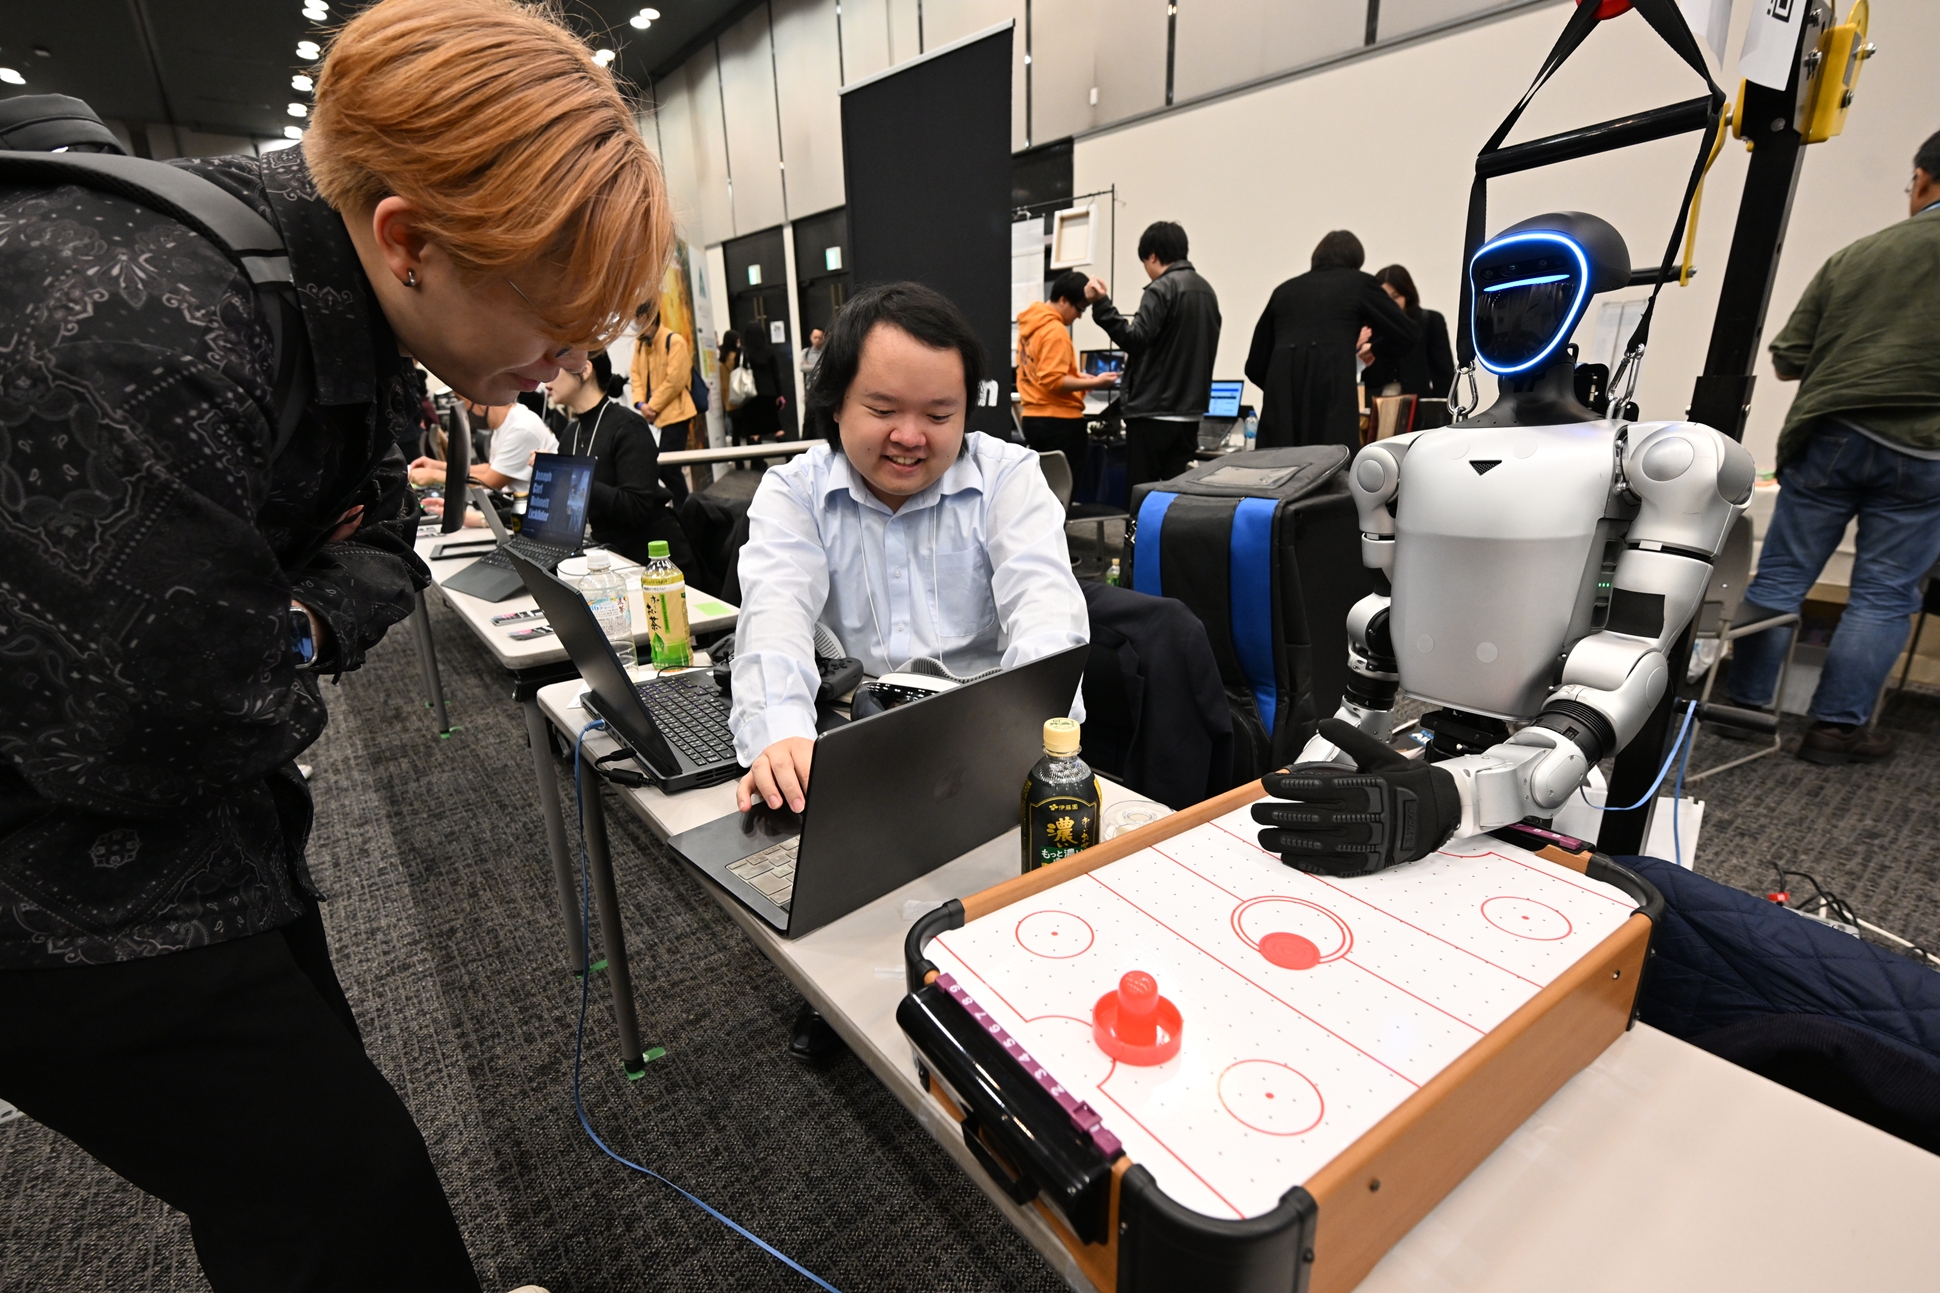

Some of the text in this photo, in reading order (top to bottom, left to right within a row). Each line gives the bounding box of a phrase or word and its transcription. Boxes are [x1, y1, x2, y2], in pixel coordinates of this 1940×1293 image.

[961, 996, 973, 1006] 8
[974, 1011, 986, 1020] 7
[1003, 1038, 1016, 1048] 5
[1018, 1053, 1031, 1062] 4
[1034, 1068, 1047, 1080] 3
[1050, 1084, 1066, 1097] 2
